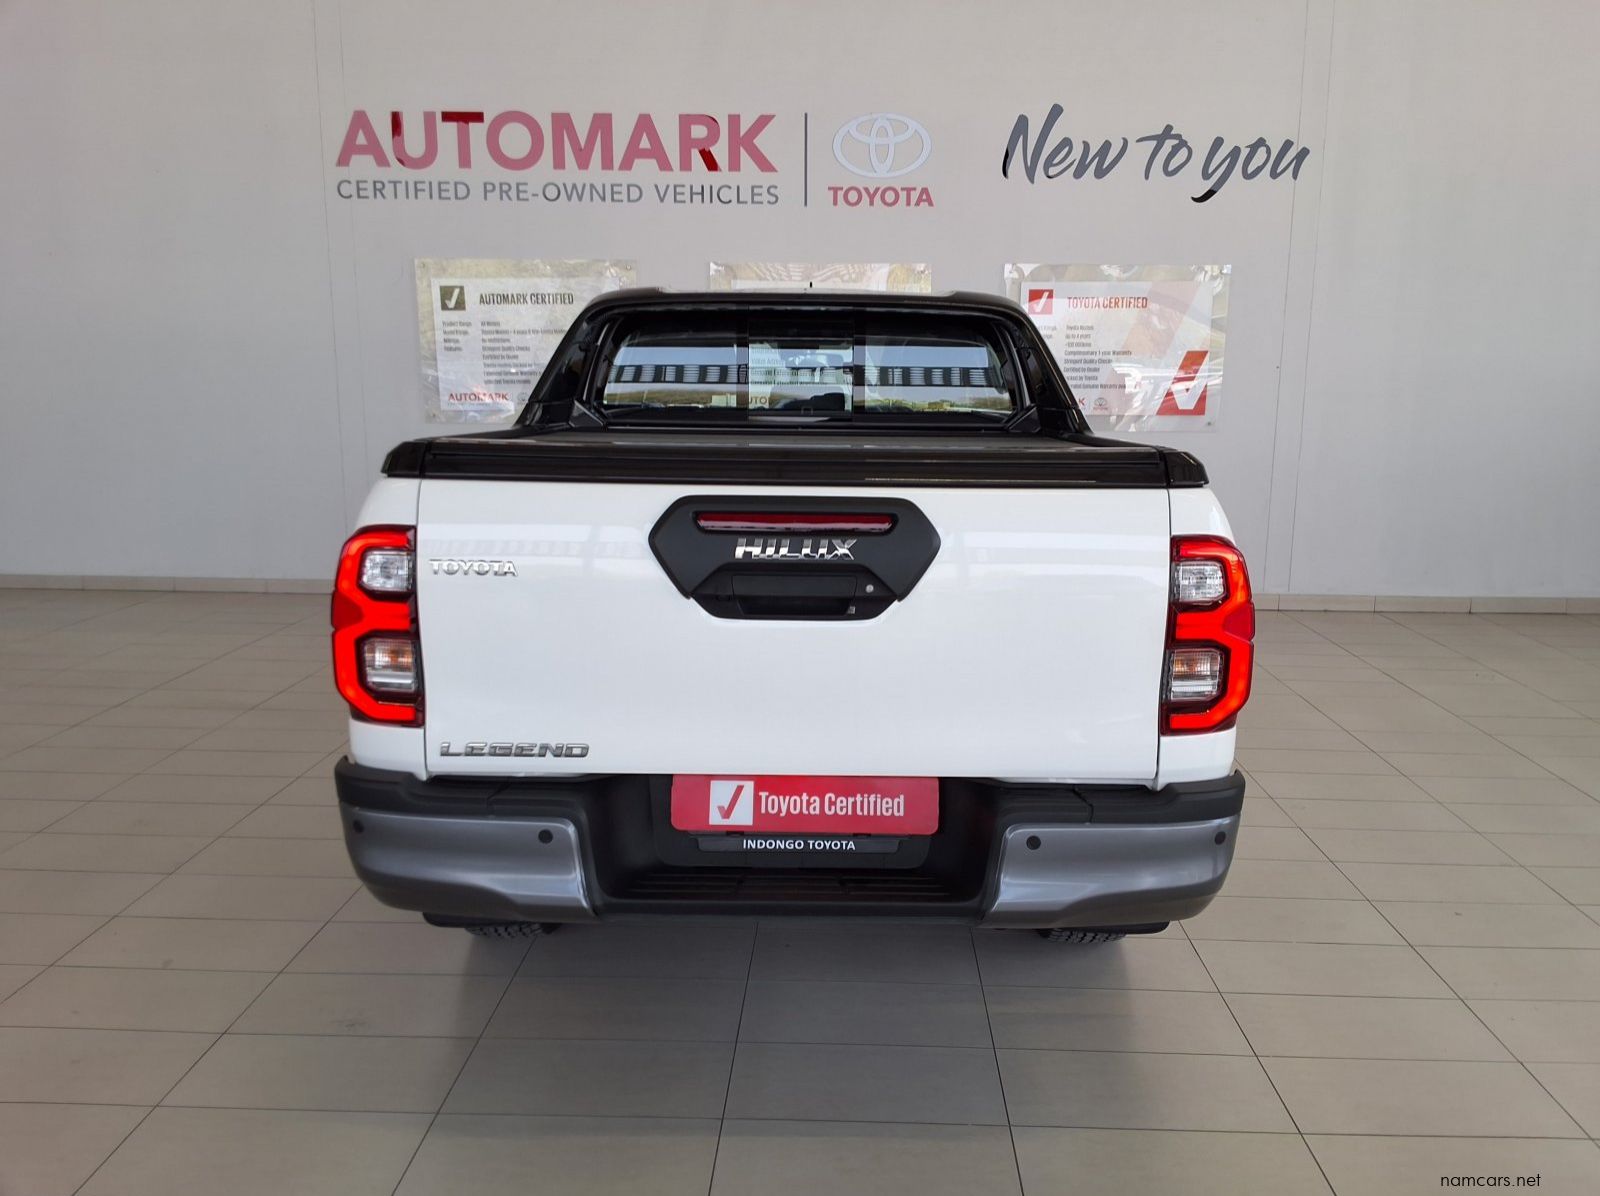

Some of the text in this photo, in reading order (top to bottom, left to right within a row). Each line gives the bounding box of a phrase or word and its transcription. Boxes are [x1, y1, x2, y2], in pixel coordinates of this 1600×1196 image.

[336, 109, 779, 173] AUTOMARK
[1002, 103, 1310, 203] New to you
[337, 179, 779, 205] CERTIFIED PRE-OWNED VEHICLES
[828, 186, 934, 207] TOYOTA
[479, 293, 574, 305] AUTOMARK CERTIFIED
[1067, 296, 1148, 309] TOYOTA CERTIFIED
[735, 537, 857, 560] HILUX
[428, 558, 518, 577] TOYOTA
[440, 741, 590, 758] LEGEND
[759, 791, 905, 817] Toyota Certified
[743, 838, 856, 851] INDONGO TOYOTA
